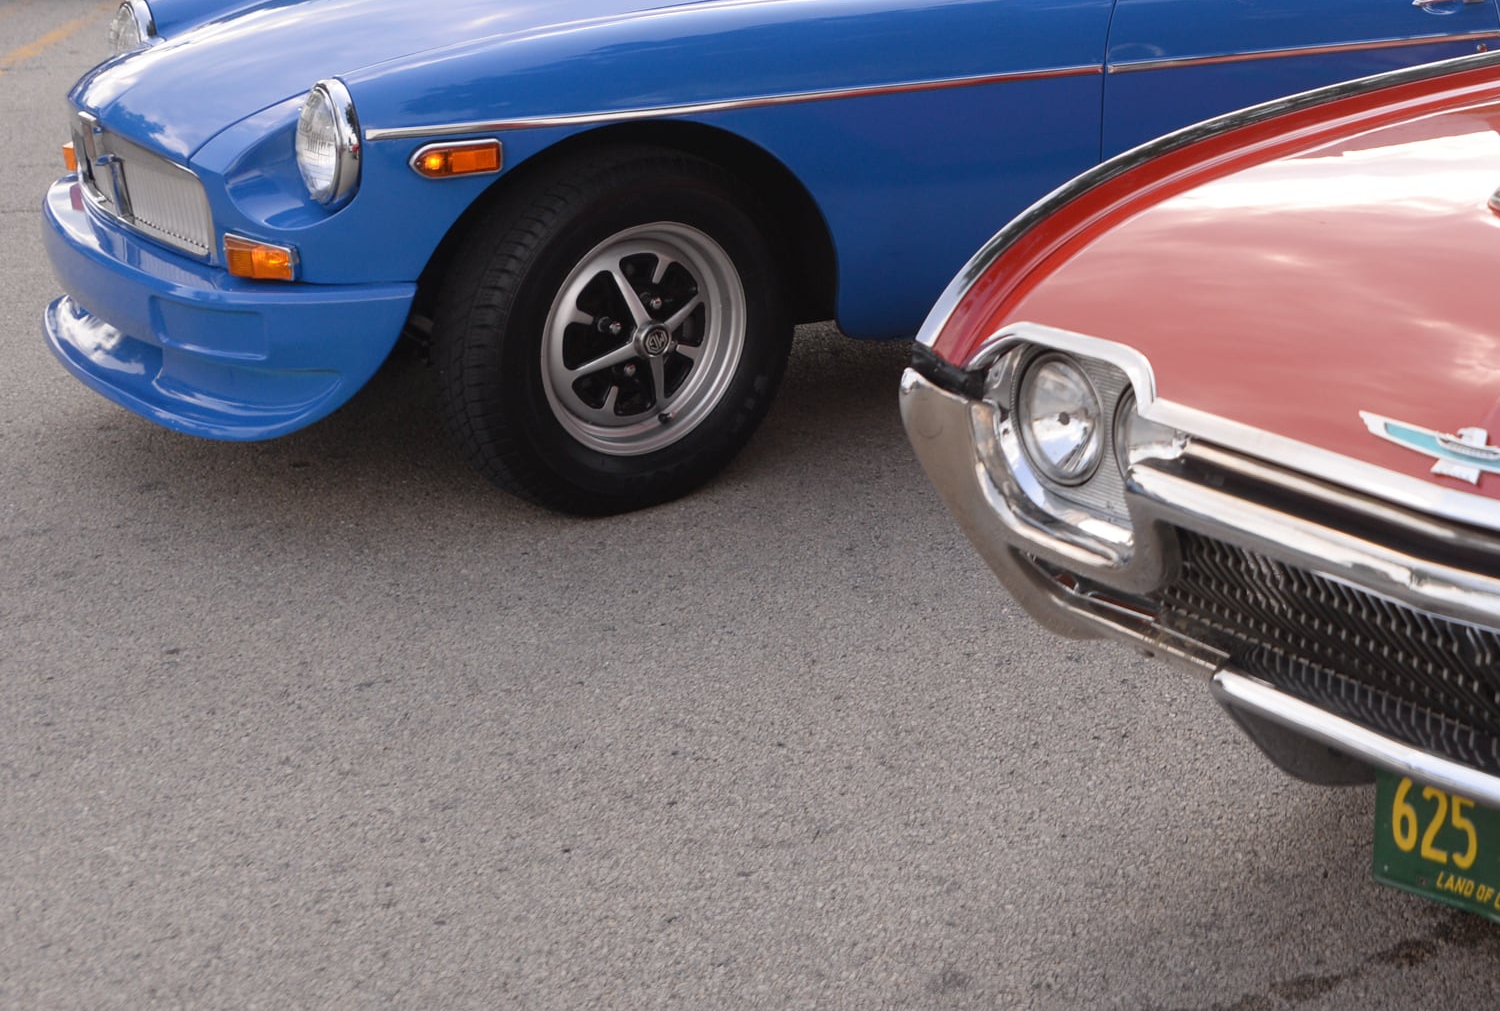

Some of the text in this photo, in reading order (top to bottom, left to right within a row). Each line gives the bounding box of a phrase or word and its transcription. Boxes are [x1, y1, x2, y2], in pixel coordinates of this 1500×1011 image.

[1392, 777, 1478, 870] 625
[1436, 871, 1475, 898] LAND
[1476, 885, 1495, 903] OF
